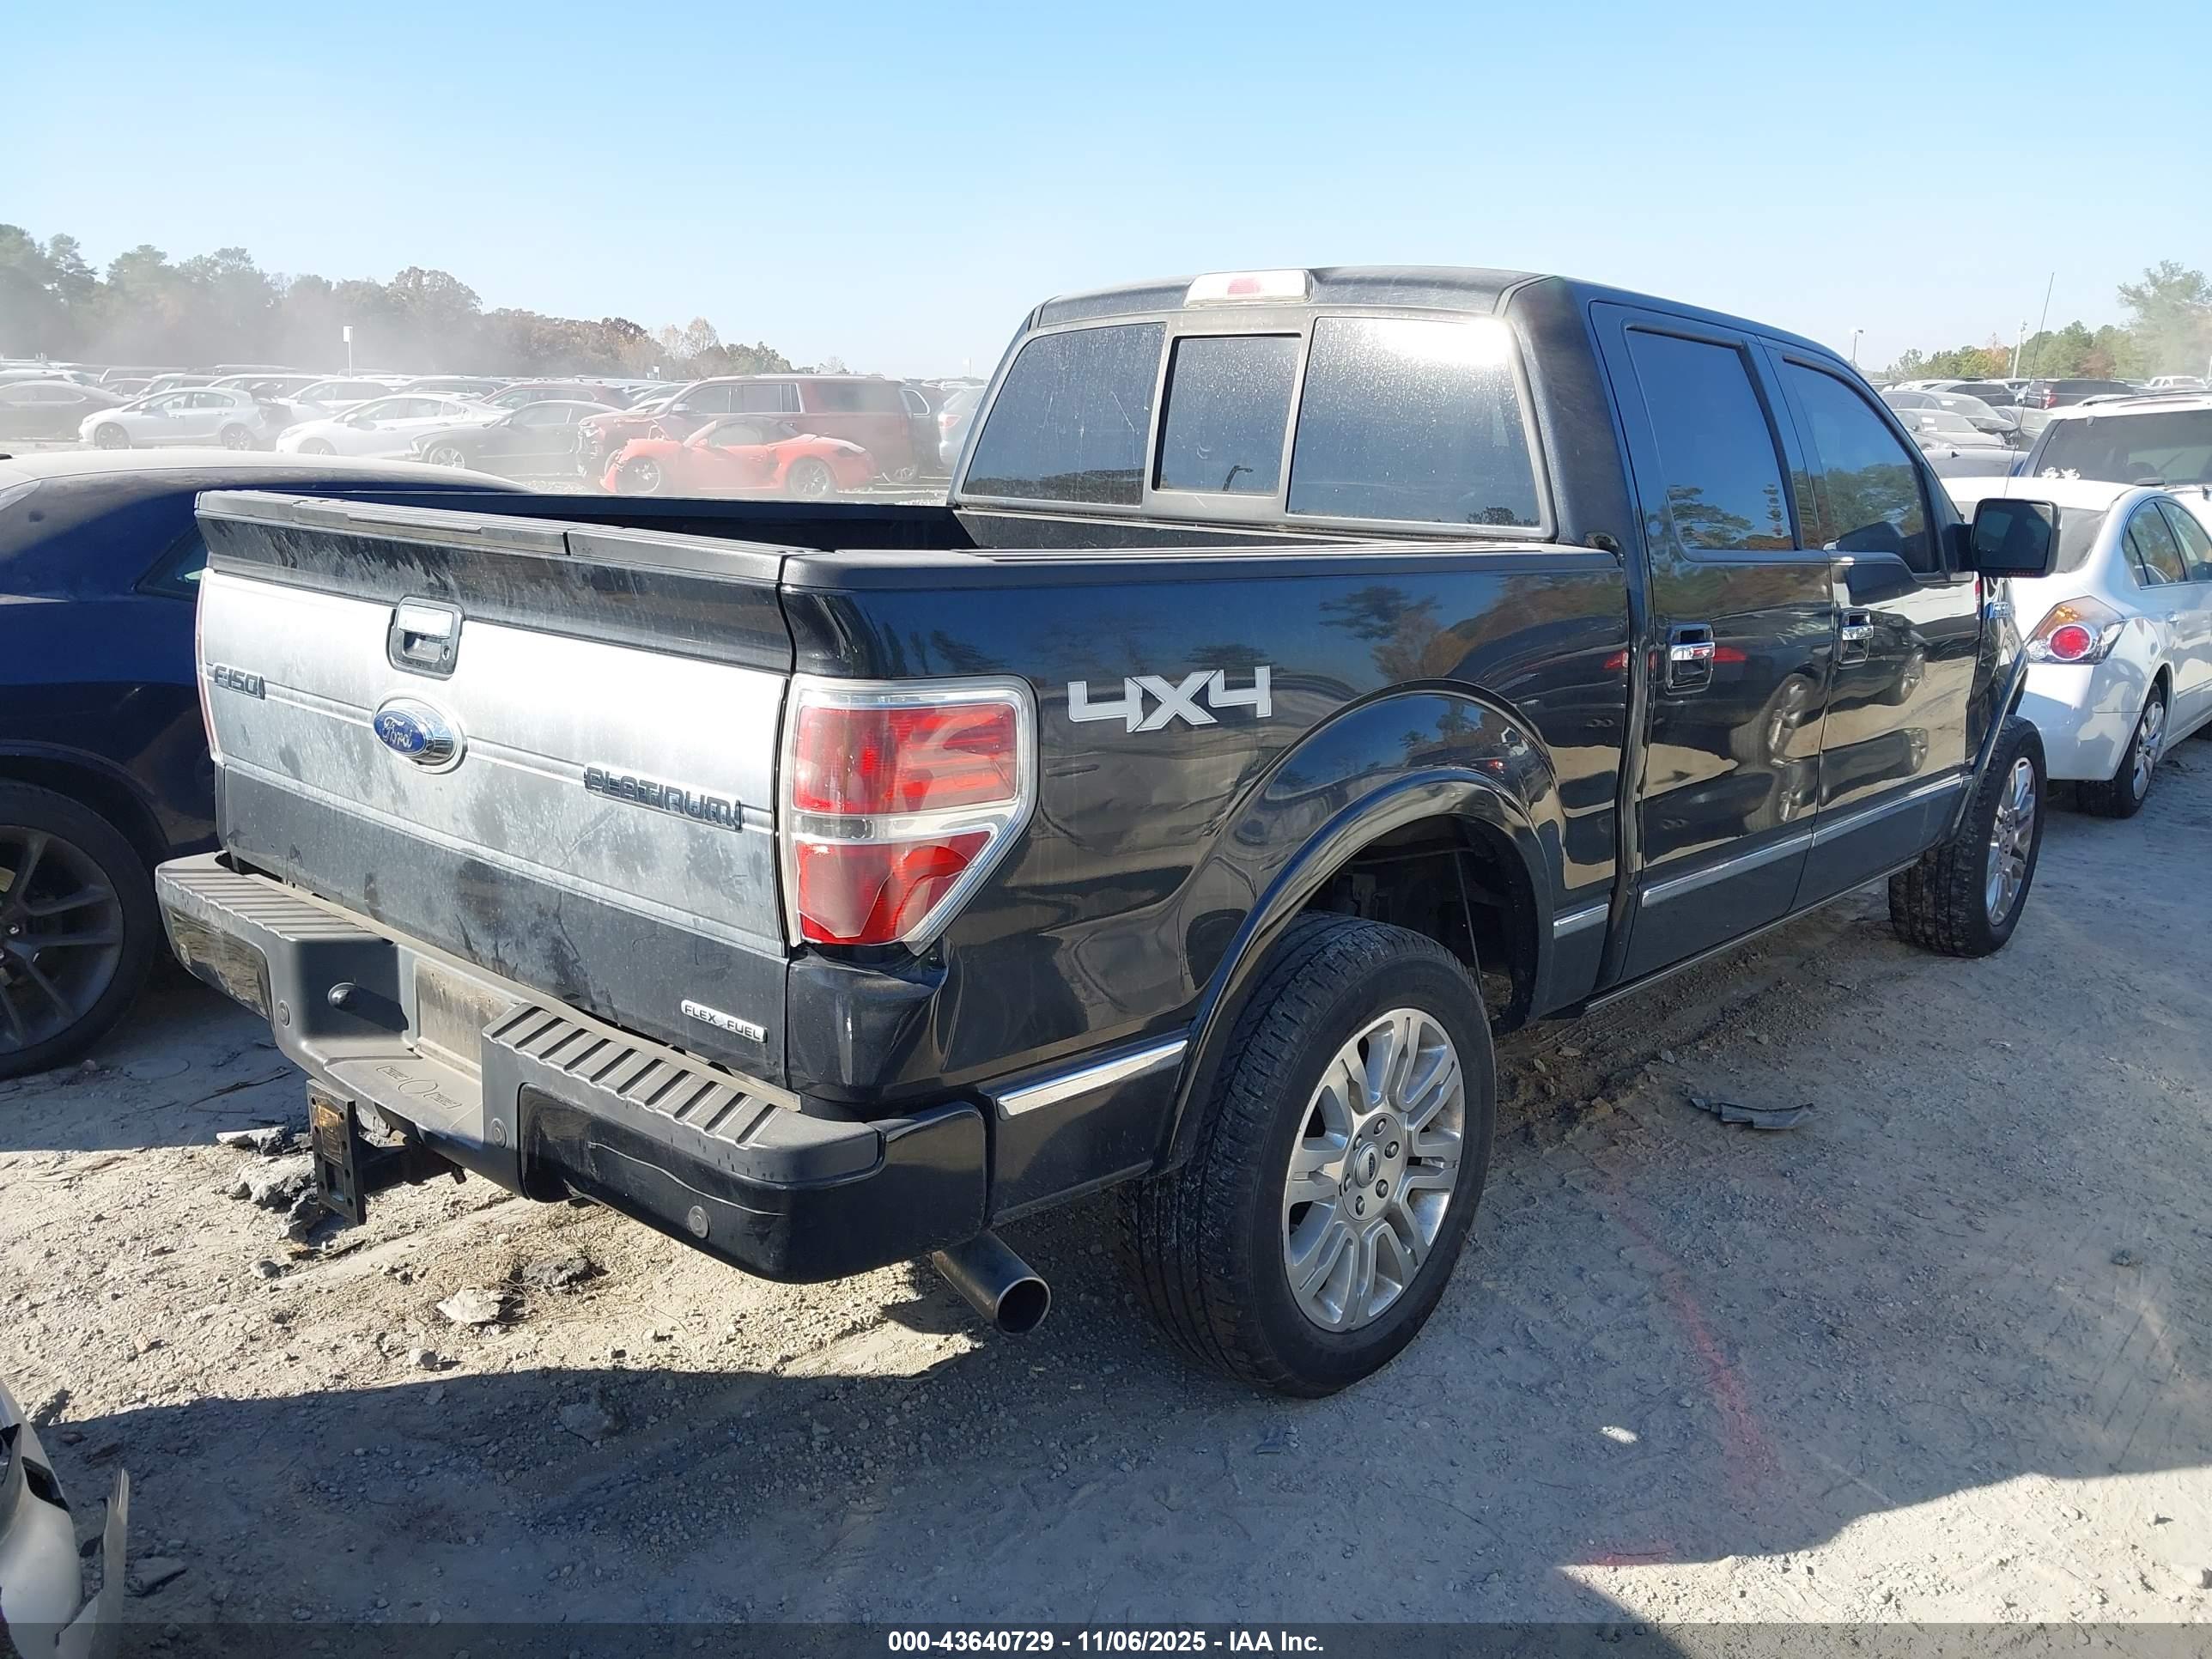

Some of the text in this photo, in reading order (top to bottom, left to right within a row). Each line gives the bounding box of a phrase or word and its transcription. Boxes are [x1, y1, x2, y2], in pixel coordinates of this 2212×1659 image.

[382, 714, 415, 750] Ford
[585, 766, 740, 830] PLATINUM
[684, 1004, 761, 1040] FLEX FUEL
